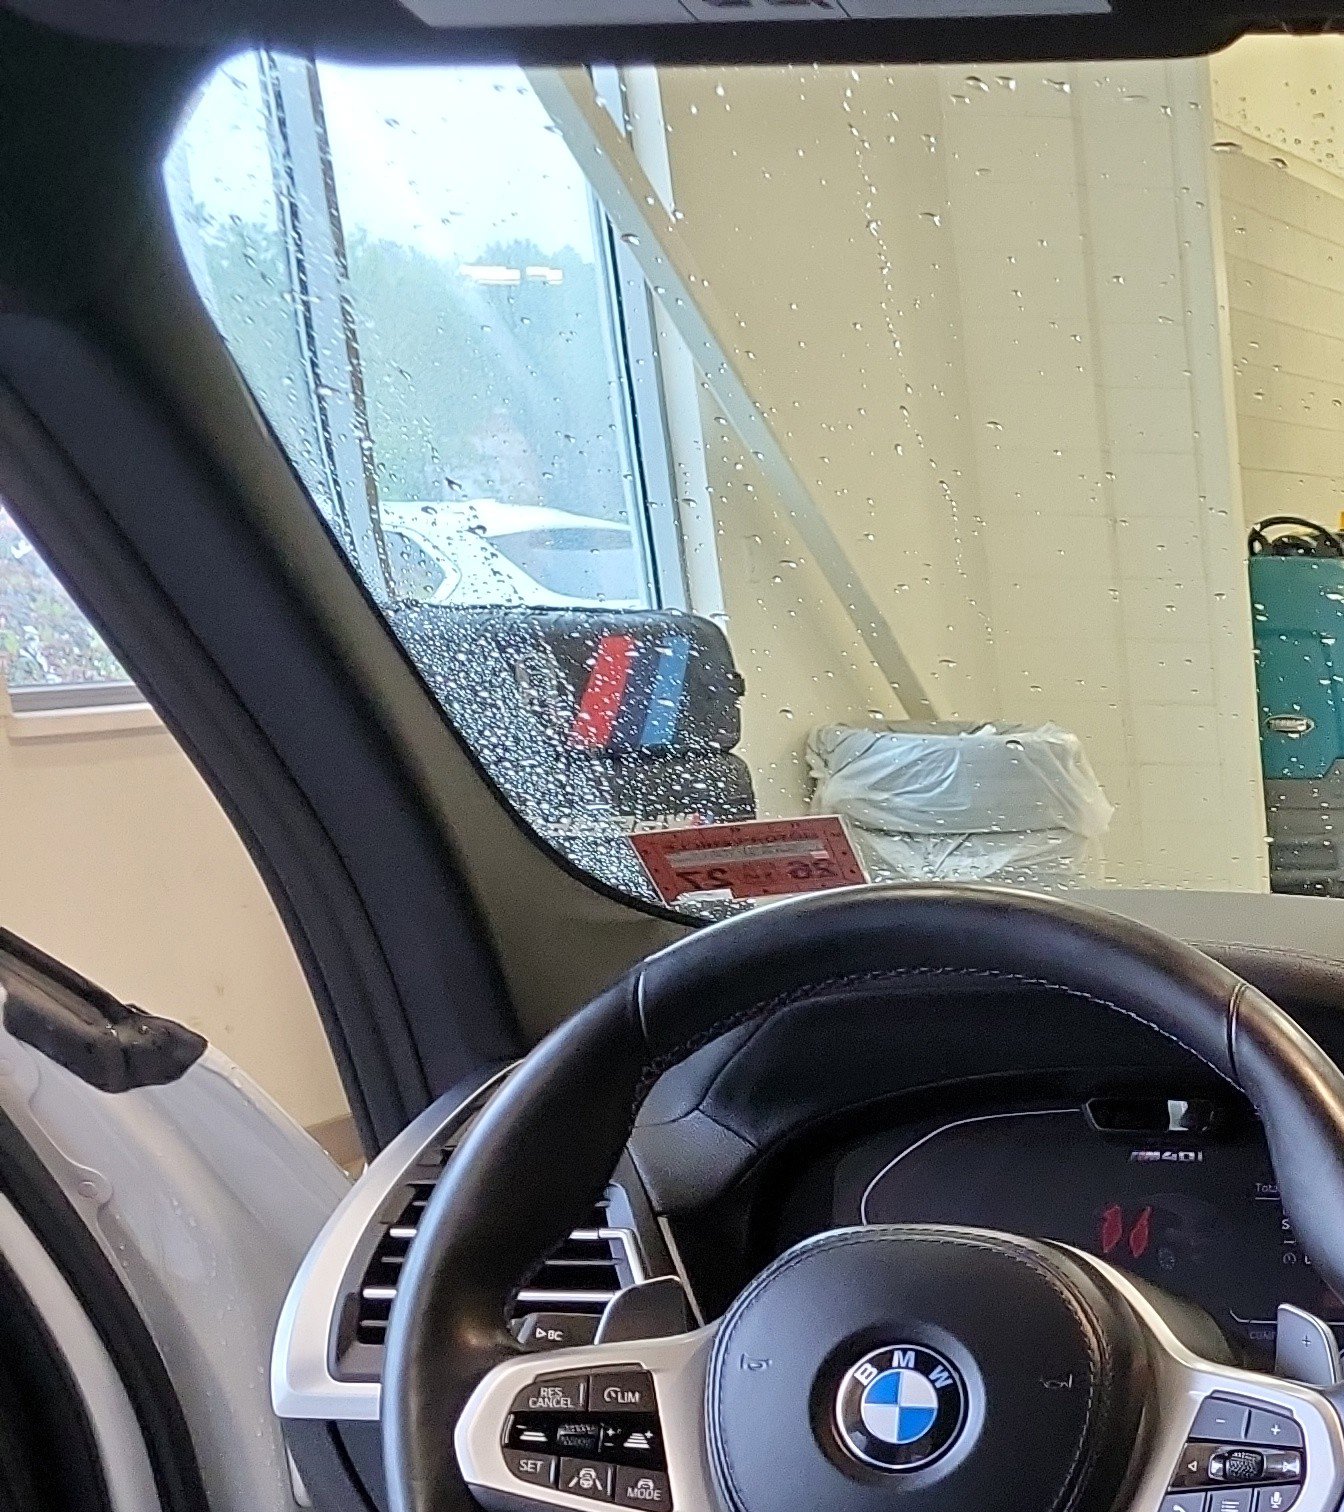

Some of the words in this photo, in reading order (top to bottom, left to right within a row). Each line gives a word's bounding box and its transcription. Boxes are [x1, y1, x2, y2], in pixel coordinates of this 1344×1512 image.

[853, 1350, 954, 1390] BMW
[540, 1387, 563, 1398] RES
[617, 1391, 640, 1404] LIM
[529, 1398, 574, 1409] CANCEL
[519, 1460, 544, 1473] SET
[627, 1487, 662, 1500] MODE
